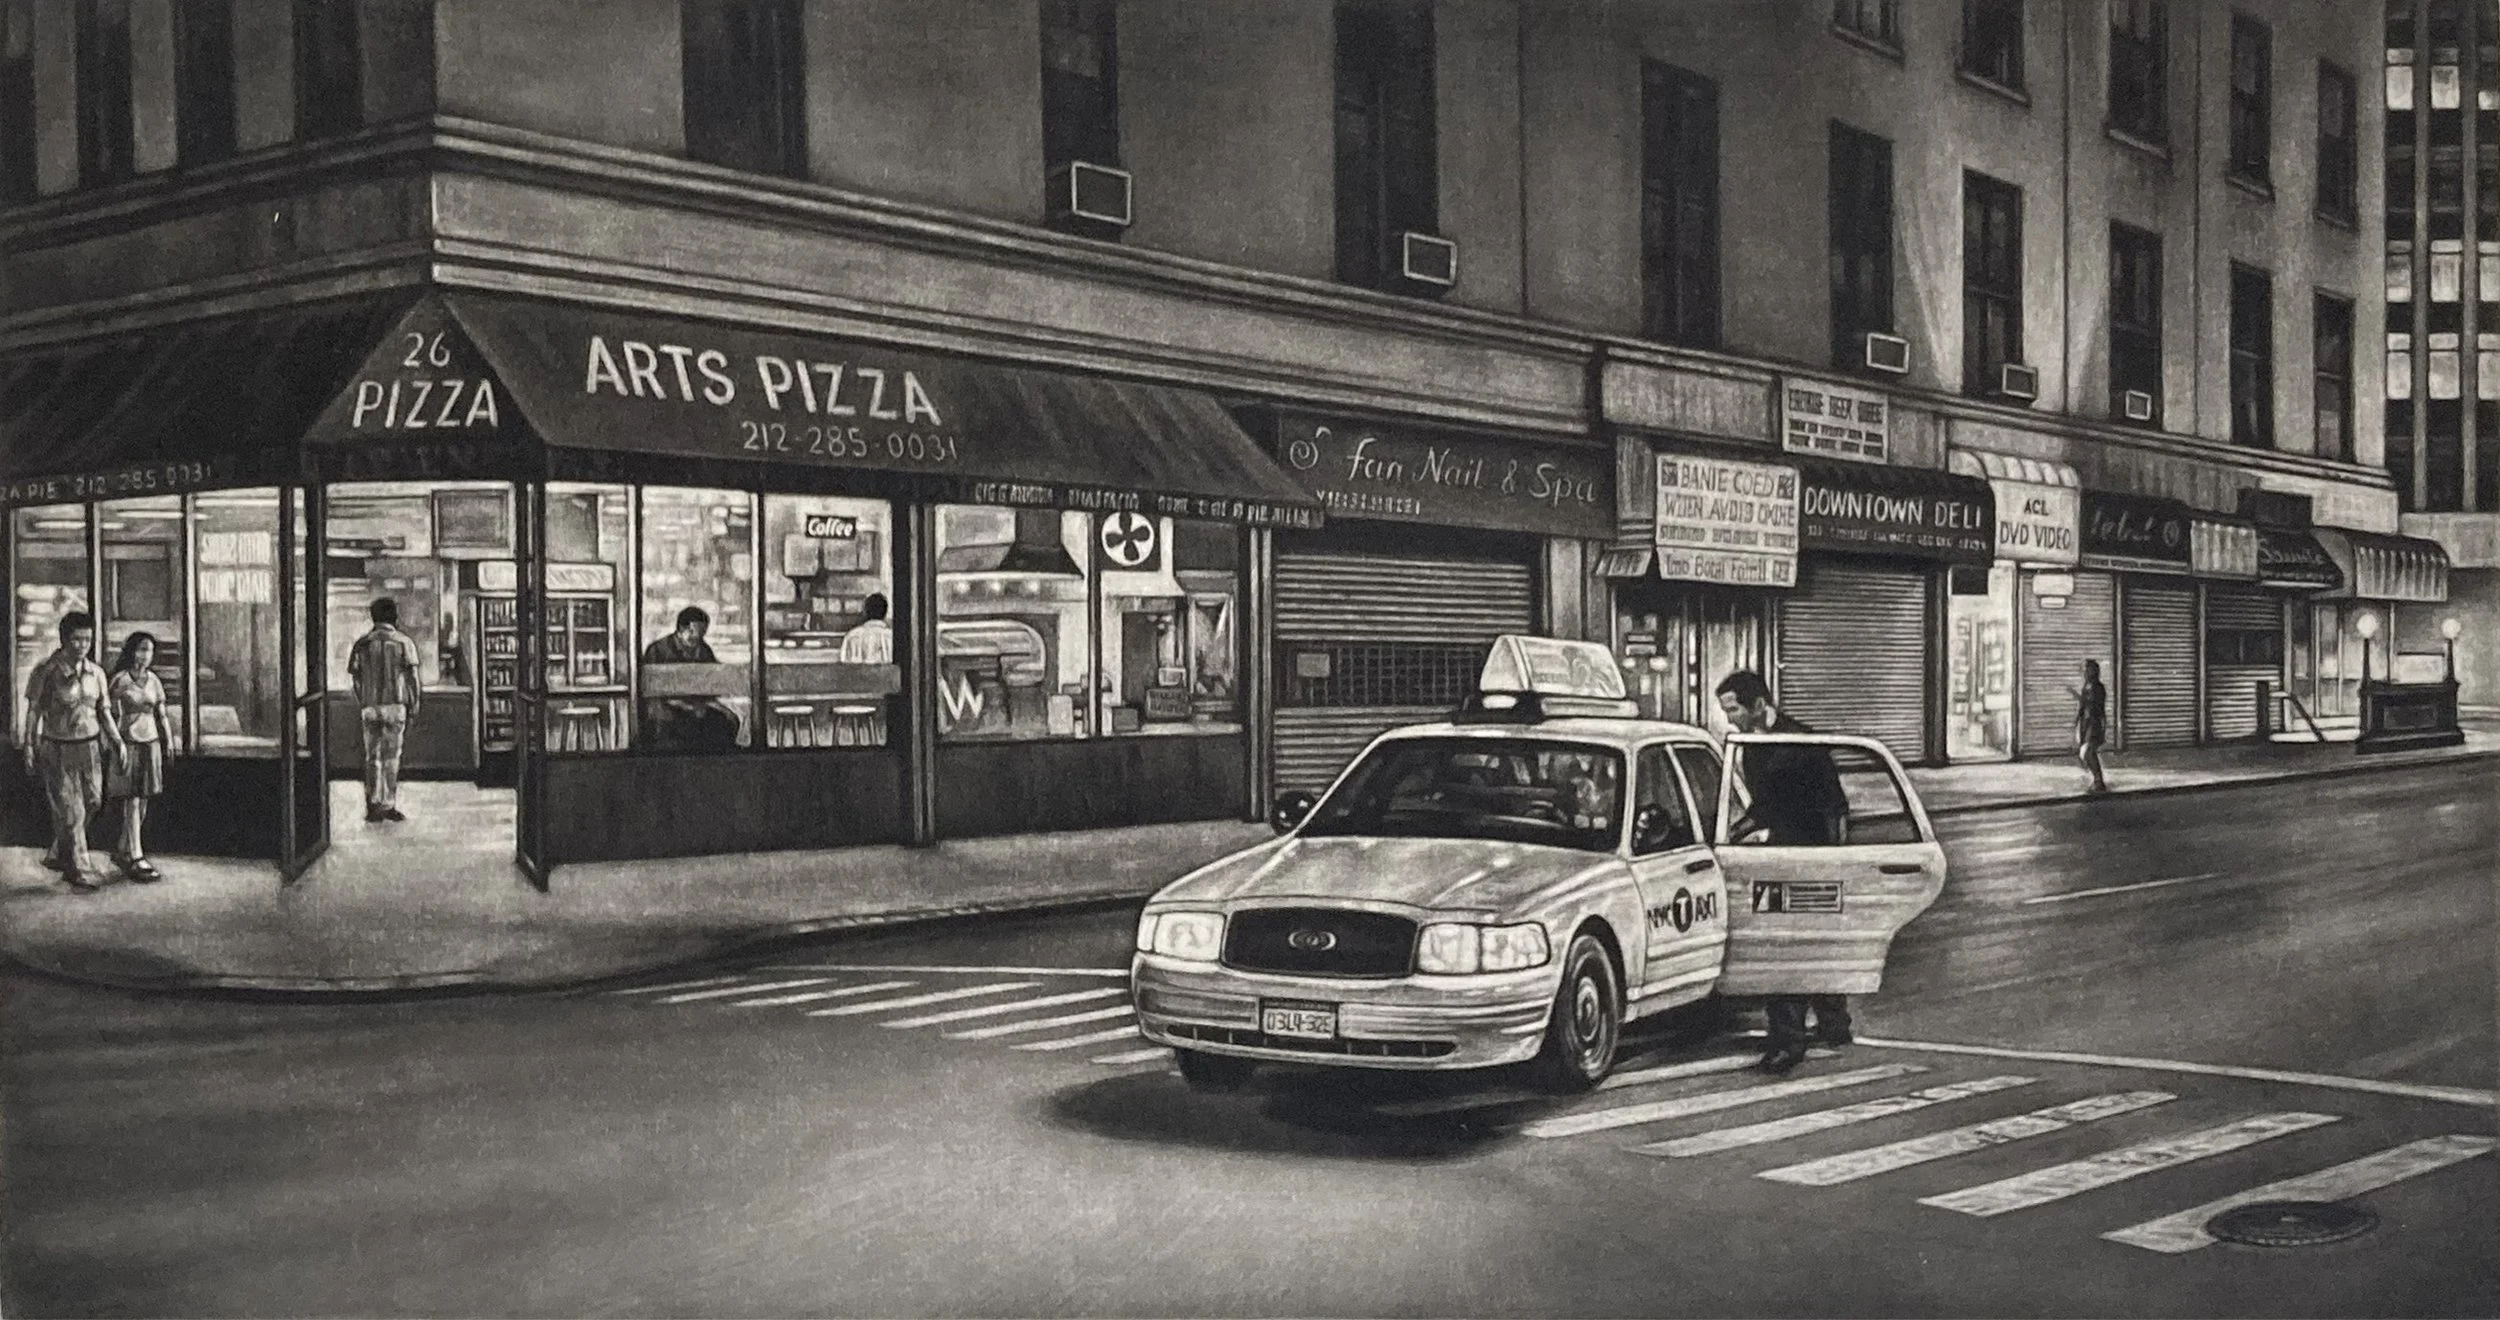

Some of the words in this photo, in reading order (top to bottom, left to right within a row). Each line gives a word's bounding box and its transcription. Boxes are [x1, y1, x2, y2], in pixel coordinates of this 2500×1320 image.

[403, 331, 450, 368] 26
[586, 335, 735, 406] ARTS
[755, 356, 942, 427] PIZZA
[352, 378, 498, 429] PIZZA
[1411, 446, 1483, 489] Nail
[1500, 458, 1518, 494] &
[1528, 462, 1597, 507] Spa
[808, 517, 853, 537] Coffee
[1804, 486, 1923, 526] DOWNTOWN
[1934, 500, 1981, 529] DELI
[2024, 498, 2049, 516] ACL
[2000, 521, 2029, 545] DVD
[2034, 524, 2071, 550] VIDEO
